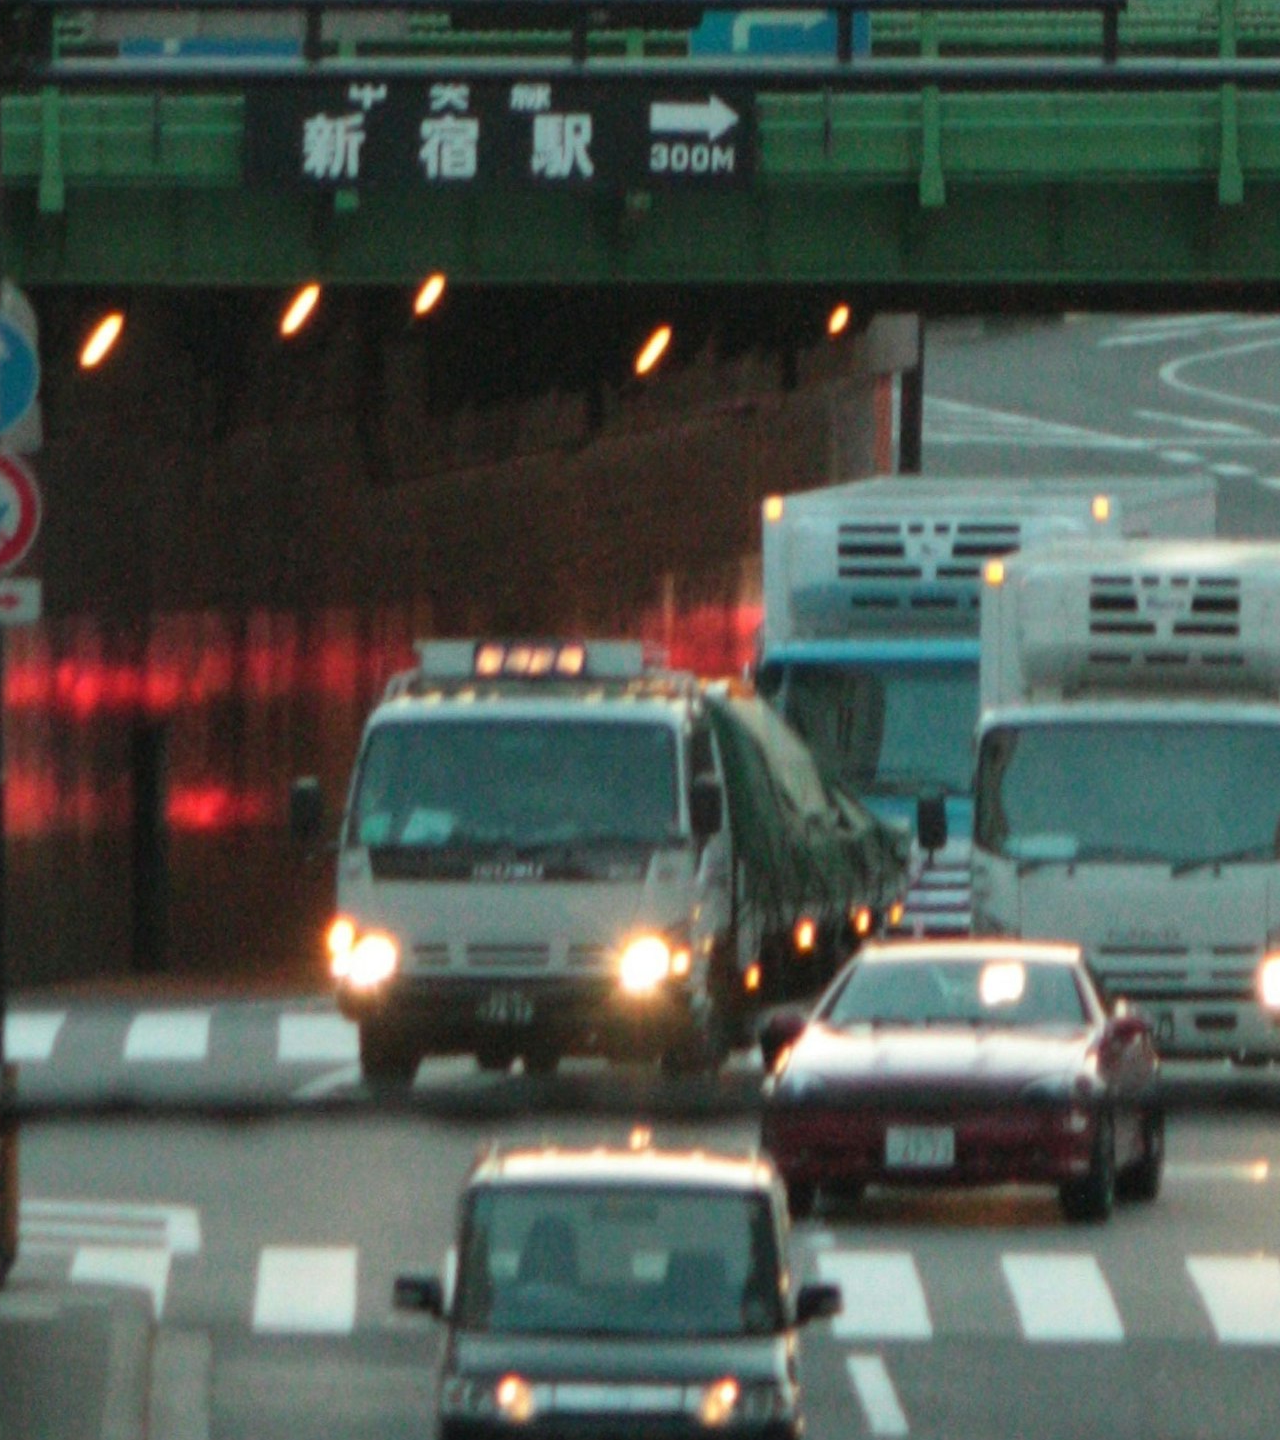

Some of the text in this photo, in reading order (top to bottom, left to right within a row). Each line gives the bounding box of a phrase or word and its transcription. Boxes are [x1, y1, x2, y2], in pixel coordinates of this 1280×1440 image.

[302, 112, 594, 180] 新宿駅
[649, 143, 735, 174] 300M
